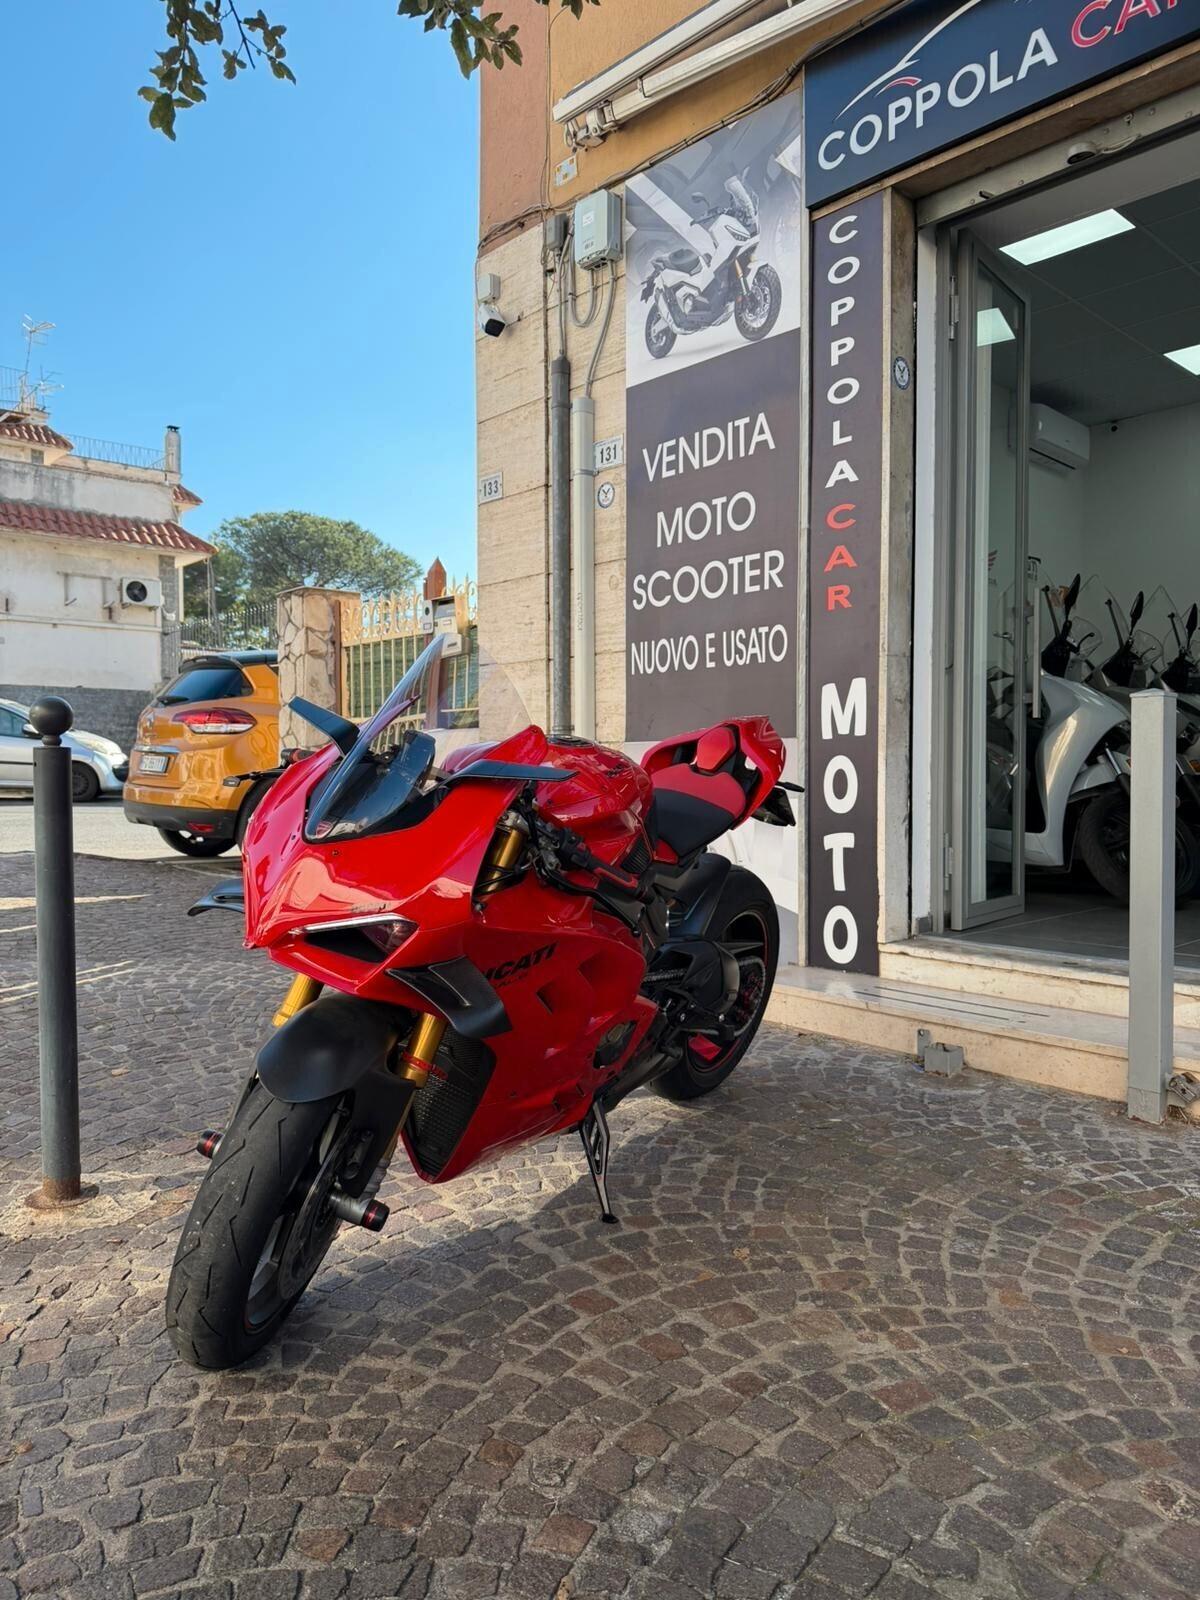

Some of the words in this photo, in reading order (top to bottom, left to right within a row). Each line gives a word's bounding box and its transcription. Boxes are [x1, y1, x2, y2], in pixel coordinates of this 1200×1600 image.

[817, 27, 1059, 171] COPPOLA
[1071, 0, 1178, 48] CA
[825, 214, 861, 489] COPPOLA
[600, 444, 617, 464] 131
[642, 412, 776, 482] VENDITA
[483, 480, 499, 497] 133
[656, 490, 756, 548] MOTO
[632, 550, 785, 611] SCOOTER
[823, 503, 858, 611] CAR
[631, 634, 699, 676] NUOVO
[705, 632, 716, 669] E
[723, 623, 788, 668] USATO
[820, 676, 868, 965] MOTO
